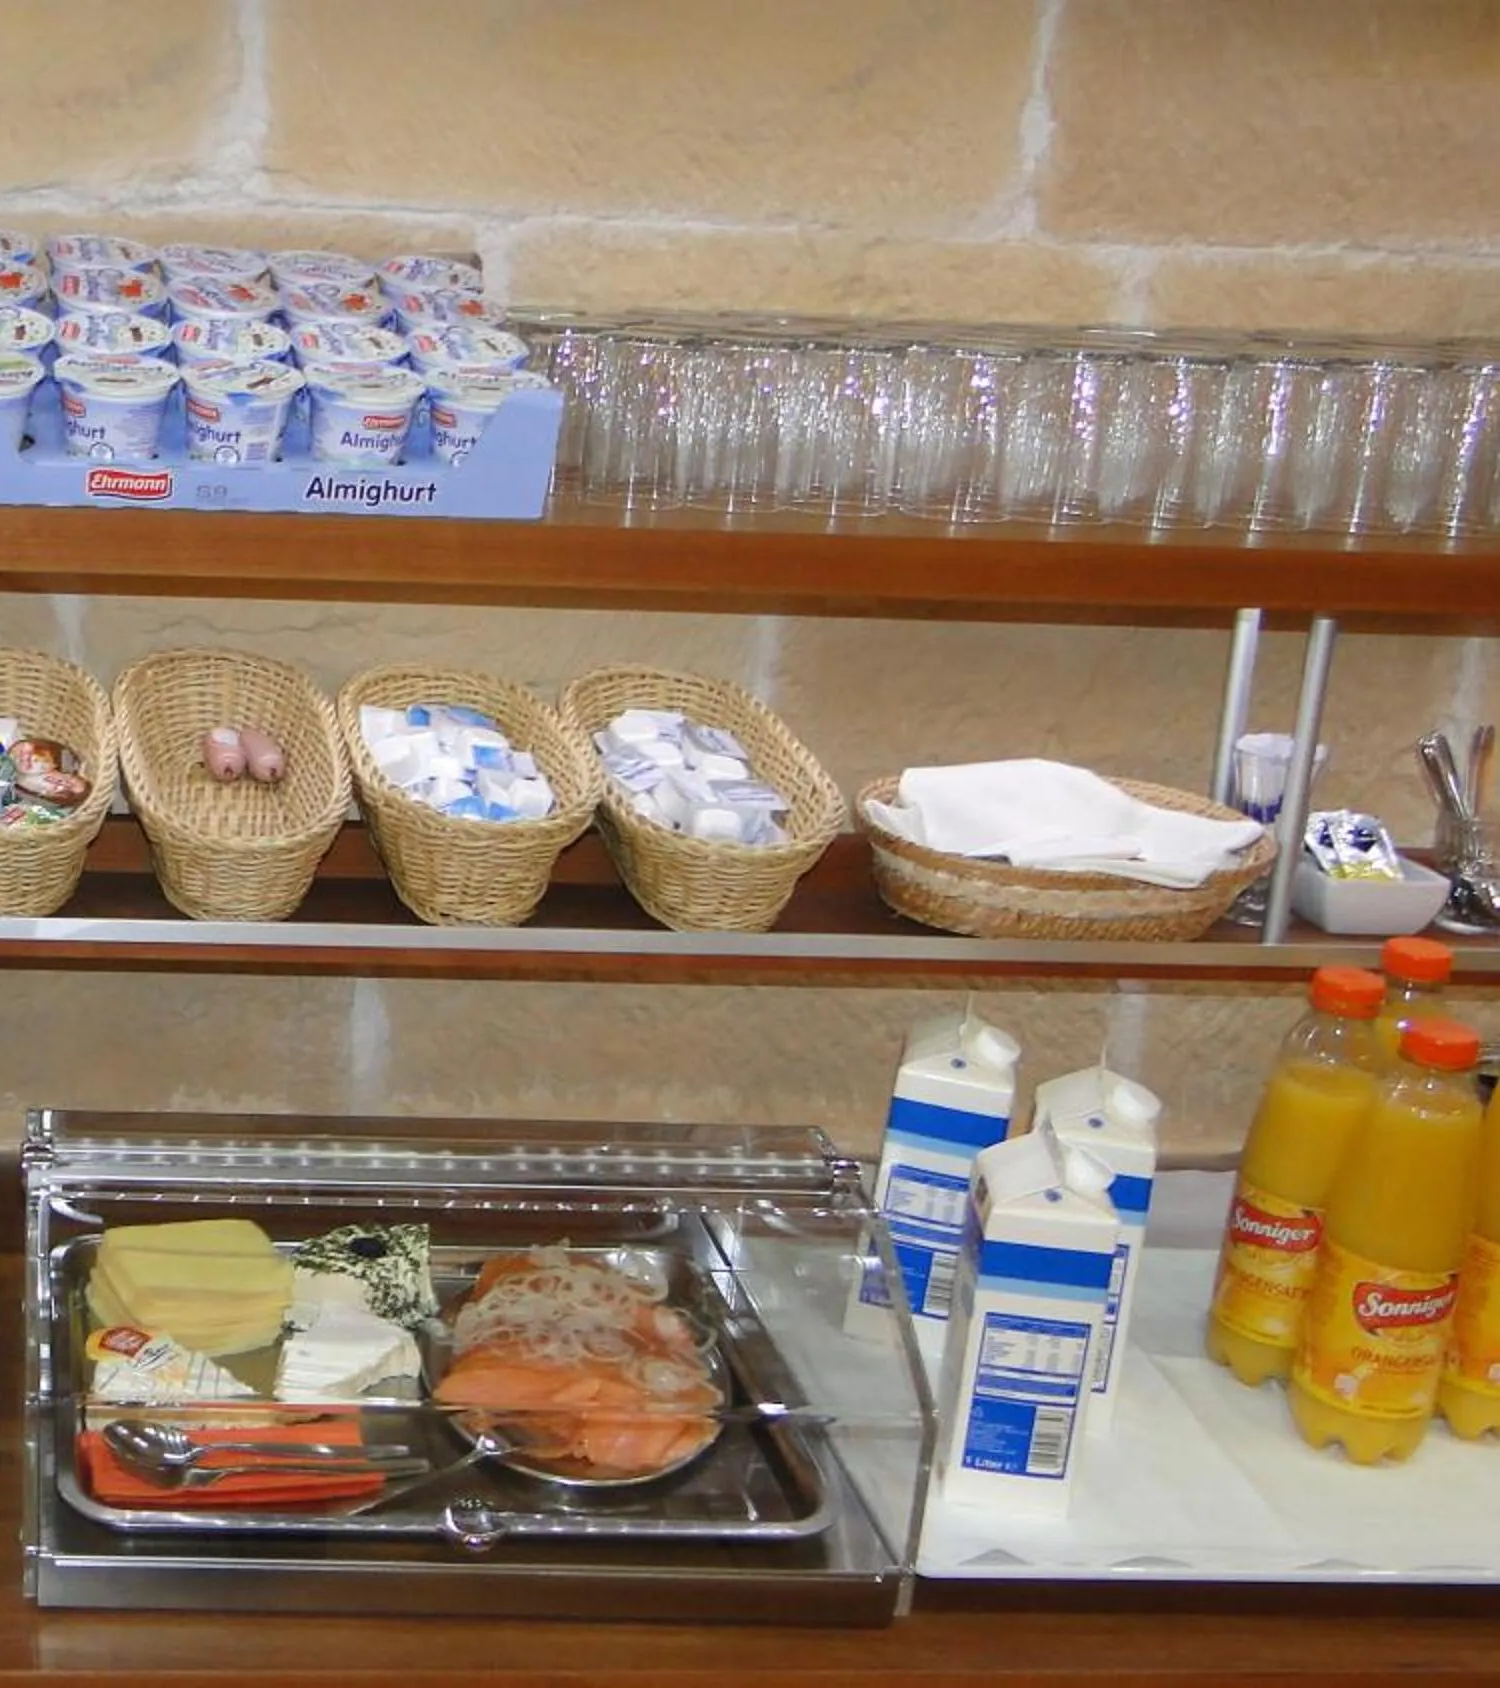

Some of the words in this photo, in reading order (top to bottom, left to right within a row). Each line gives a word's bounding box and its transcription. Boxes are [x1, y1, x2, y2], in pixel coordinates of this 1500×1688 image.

[90, 472, 166, 492] Ehrmann
[305, 476, 436, 506] Almighurt
[1236, 1205, 1317, 1246] Sonniger
